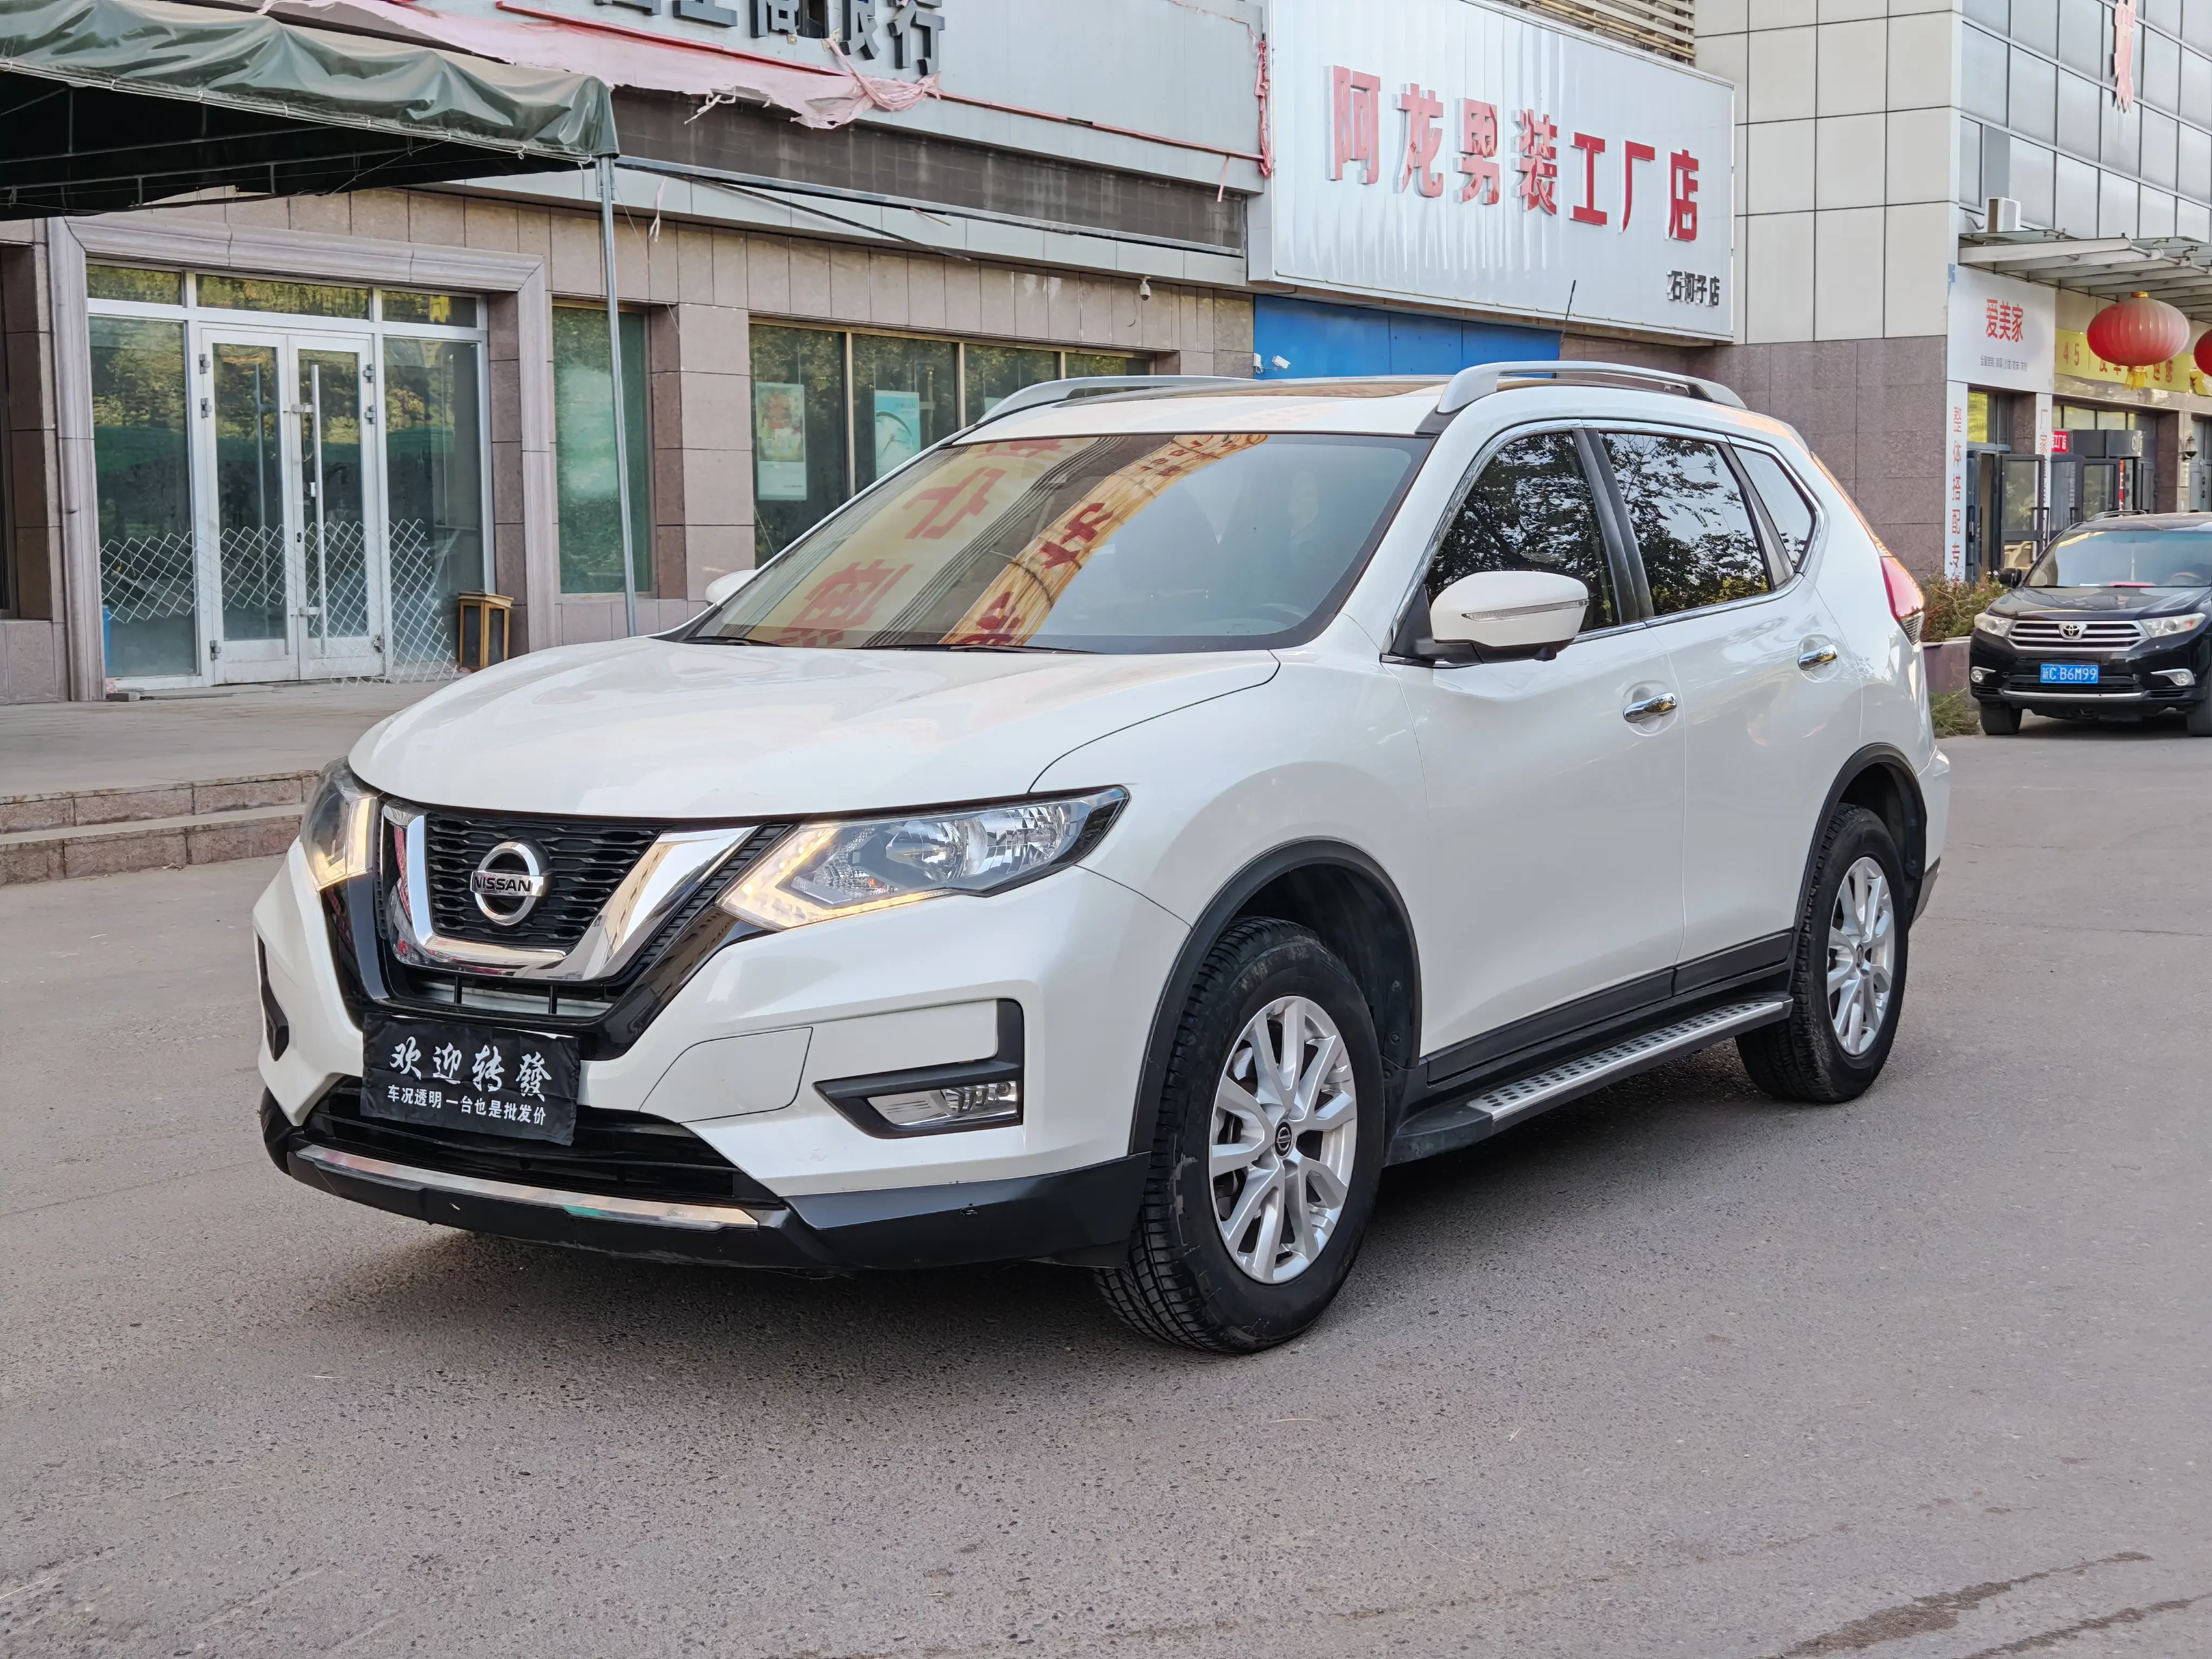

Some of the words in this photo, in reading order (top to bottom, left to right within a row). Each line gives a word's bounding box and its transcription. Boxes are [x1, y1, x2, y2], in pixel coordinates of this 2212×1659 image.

[1324, 65, 1700, 241] 阿龙男装工厂店
[1666, 270, 1721, 307] 石河子店
[1986, 299, 2024, 342] 爱美家
[473, 876, 531, 892] NISSAN
[387, 1084, 442, 1109] 车况透明
[446, 1095, 547, 1126] 一台也是批发价
